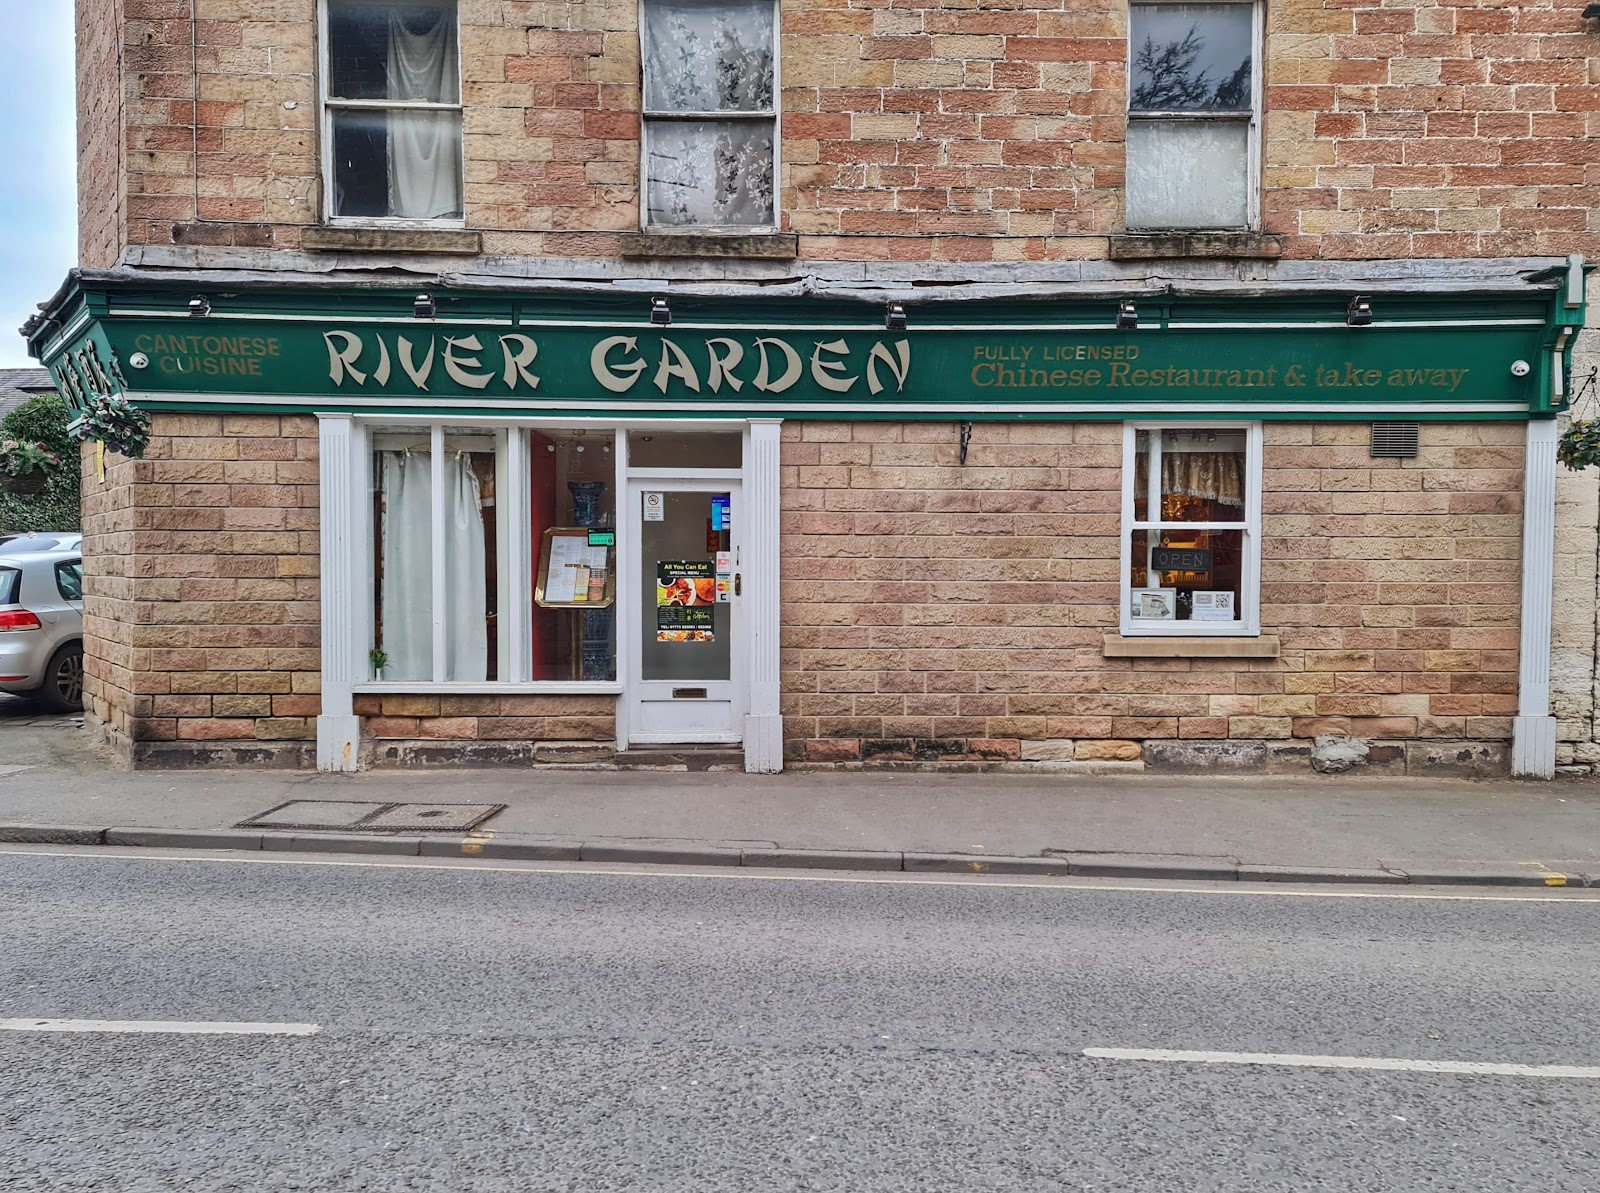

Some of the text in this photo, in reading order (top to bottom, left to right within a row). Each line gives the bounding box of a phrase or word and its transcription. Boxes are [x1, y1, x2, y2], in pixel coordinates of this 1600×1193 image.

[135, 334, 281, 357] CANTONESE
[973, 345, 1140, 360] FULLY LICENSED
[159, 355, 262, 376] CUISINE
[322, 330, 911, 396] RIVER GARDEN
[970, 361, 1470, 393] Chinese Restaurant & take away
[1159, 553, 1203, 566] OPEN
